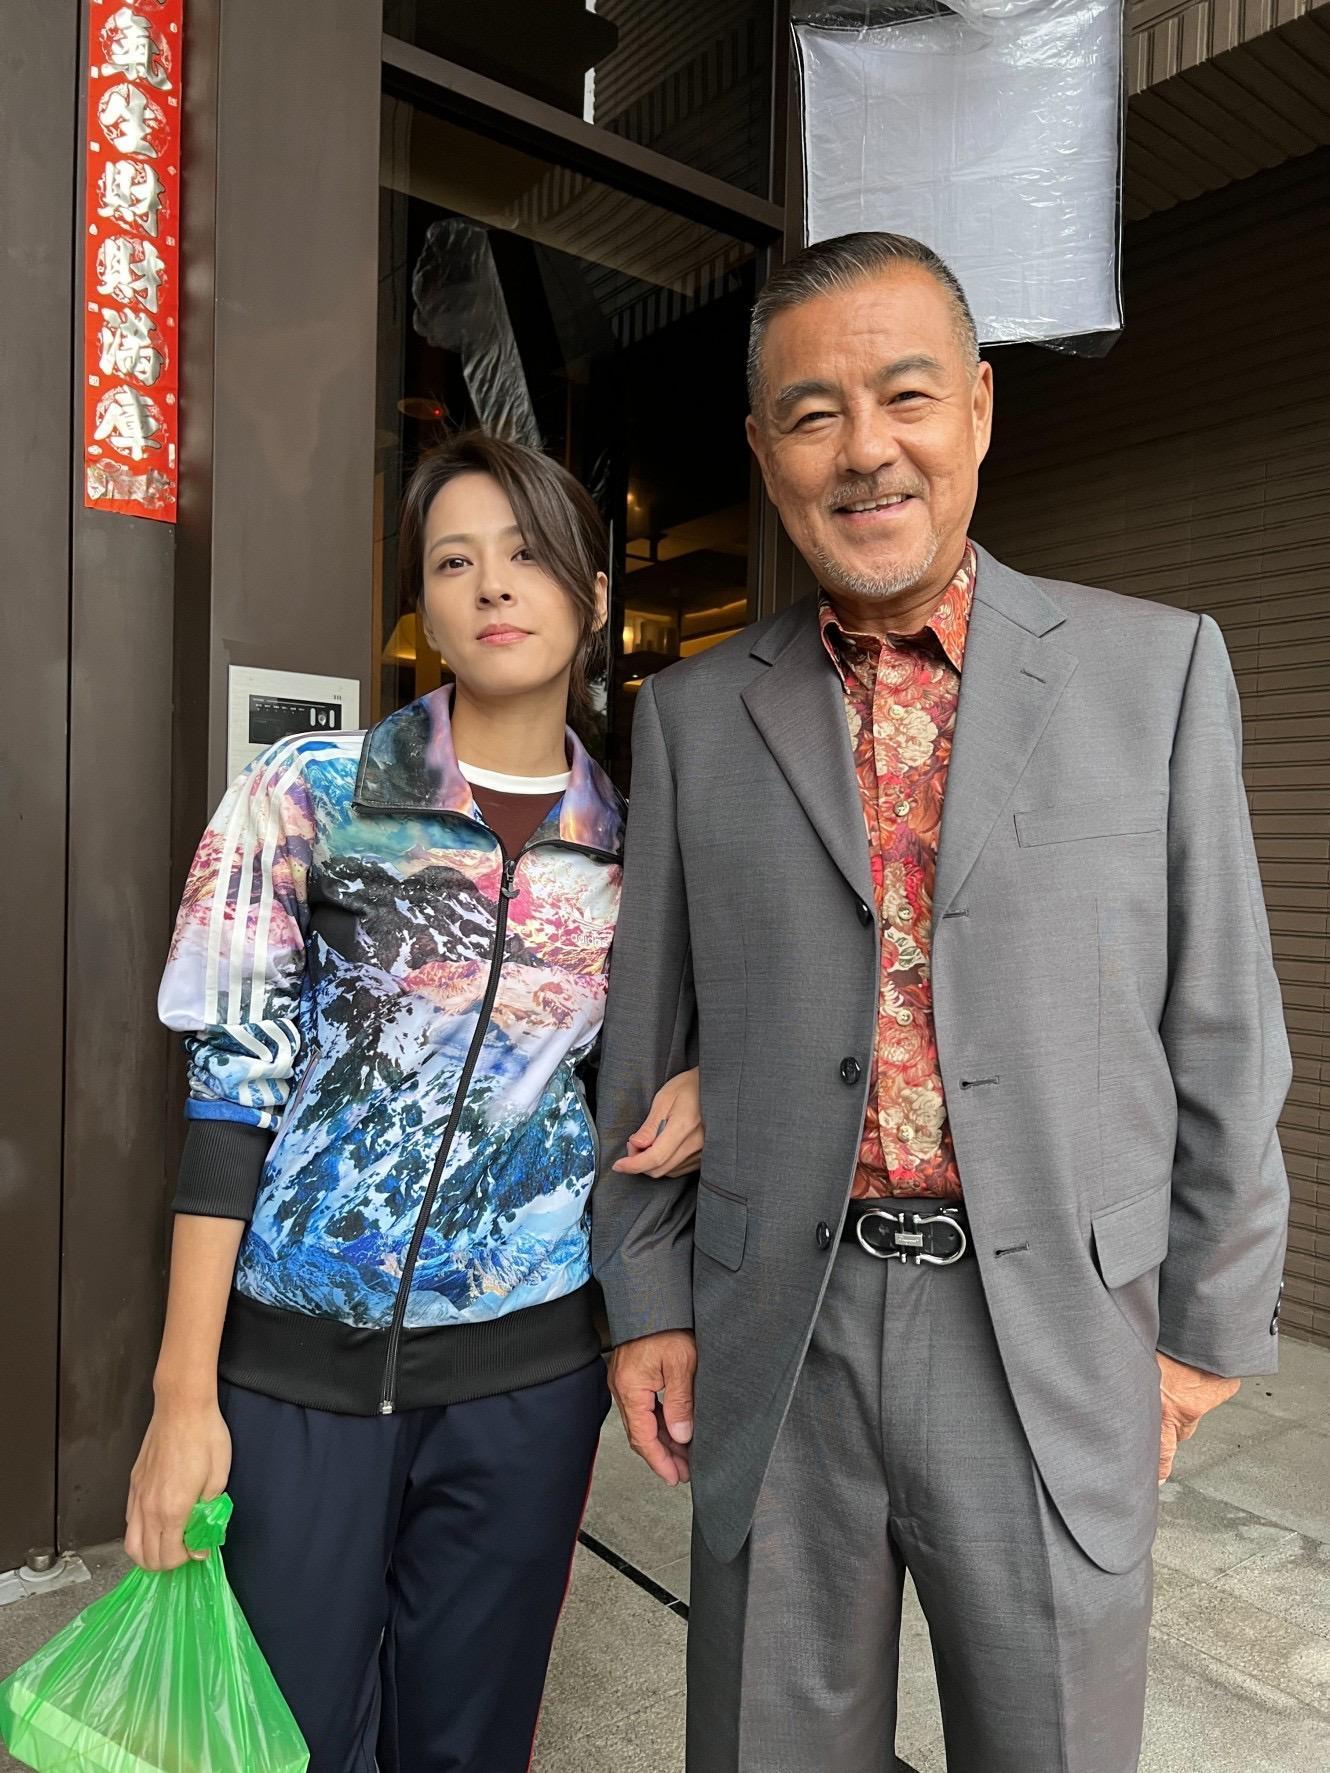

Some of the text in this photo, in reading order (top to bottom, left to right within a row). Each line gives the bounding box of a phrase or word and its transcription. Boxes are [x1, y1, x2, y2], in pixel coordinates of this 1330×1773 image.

[93, 0, 173, 461] 氣生財財滿庫
